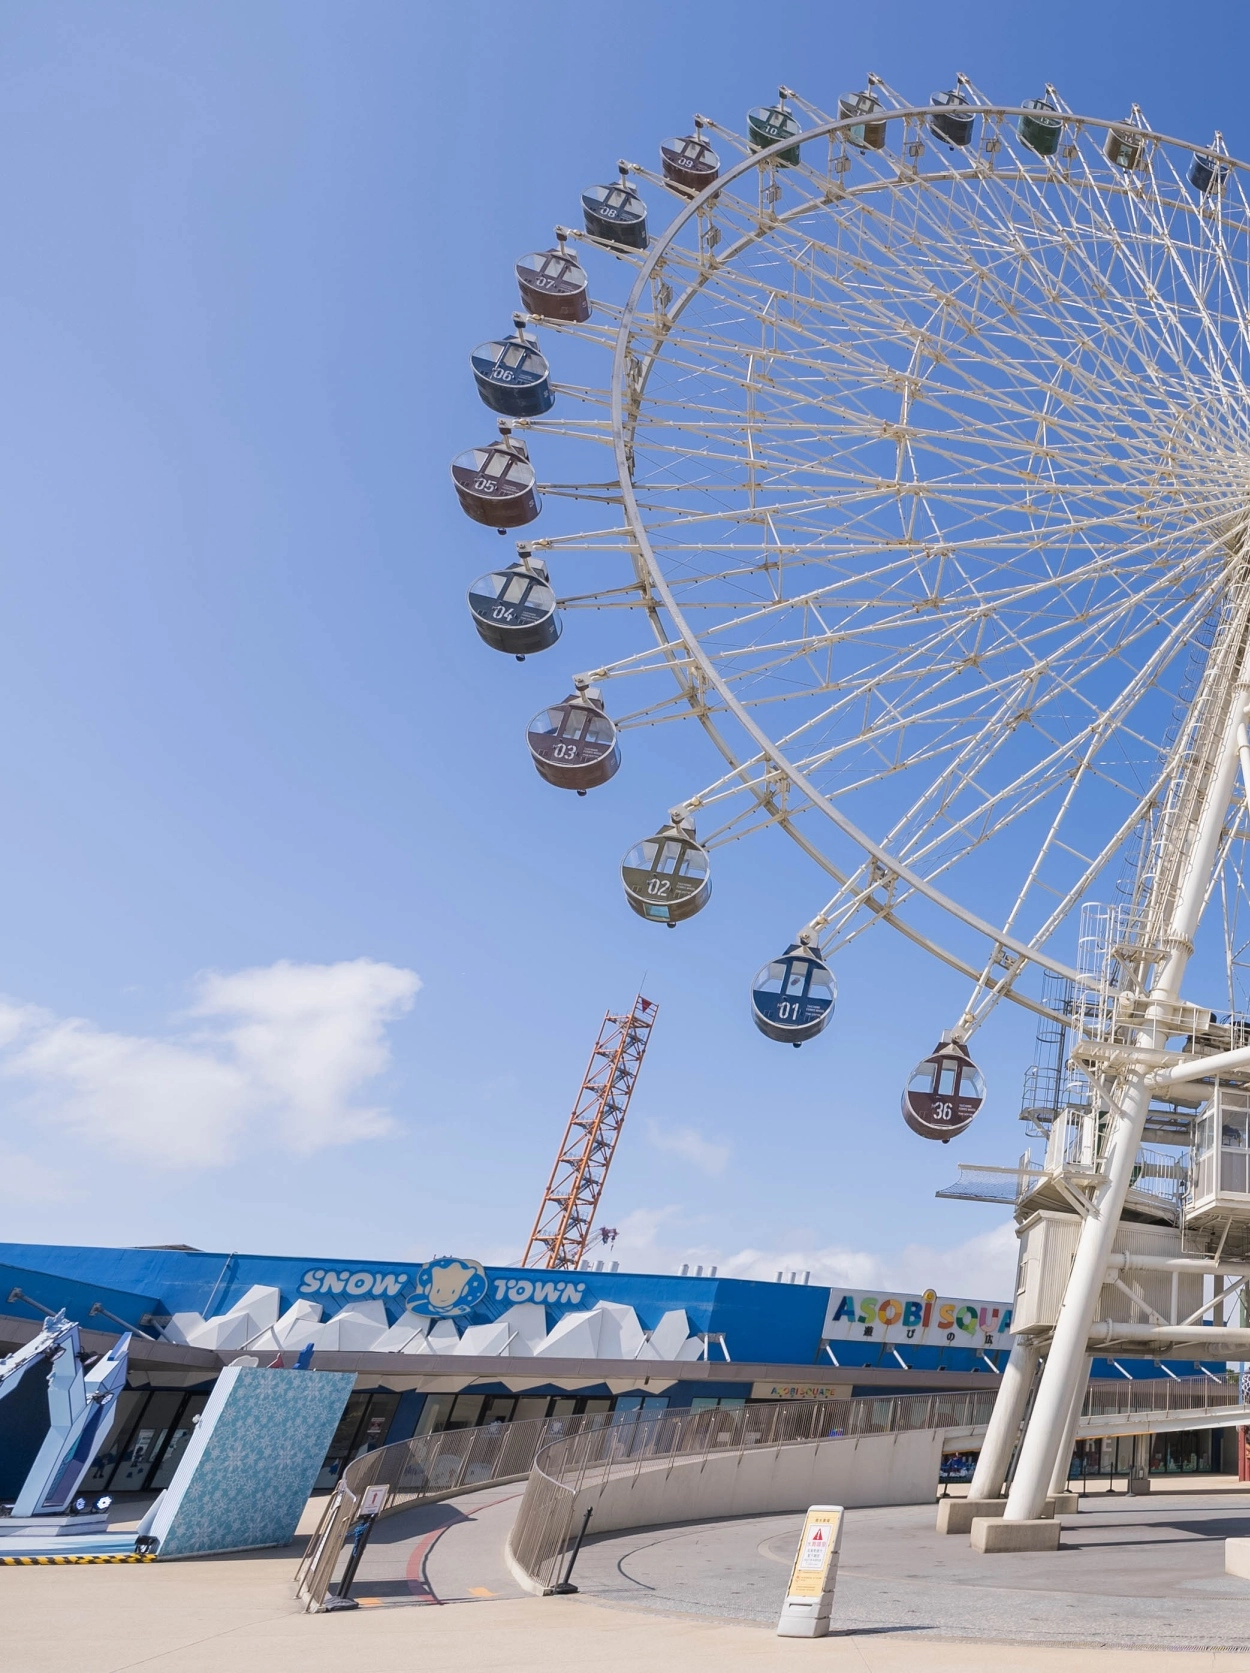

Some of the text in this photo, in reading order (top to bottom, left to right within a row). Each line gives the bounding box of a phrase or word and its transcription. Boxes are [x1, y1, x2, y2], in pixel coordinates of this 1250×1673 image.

[764, 125, 777, 135] 10
[678, 157, 694, 168] 09
[600, 206, 617, 218] 08
[536, 276, 554, 289] 07
[493, 367, 513, 381] 06
[474, 478, 497, 492] 05
[492, 605, 514, 621] 04
[553, 743, 577, 760] 03
[647, 878, 671, 896] 02
[779, 1001, 800, 1020] 01
[933, 1101, 953, 1120] 36
[299, 1269, 586, 1304] SNOW TOWN
[832, 1290, 935, 1328] ASOBI
